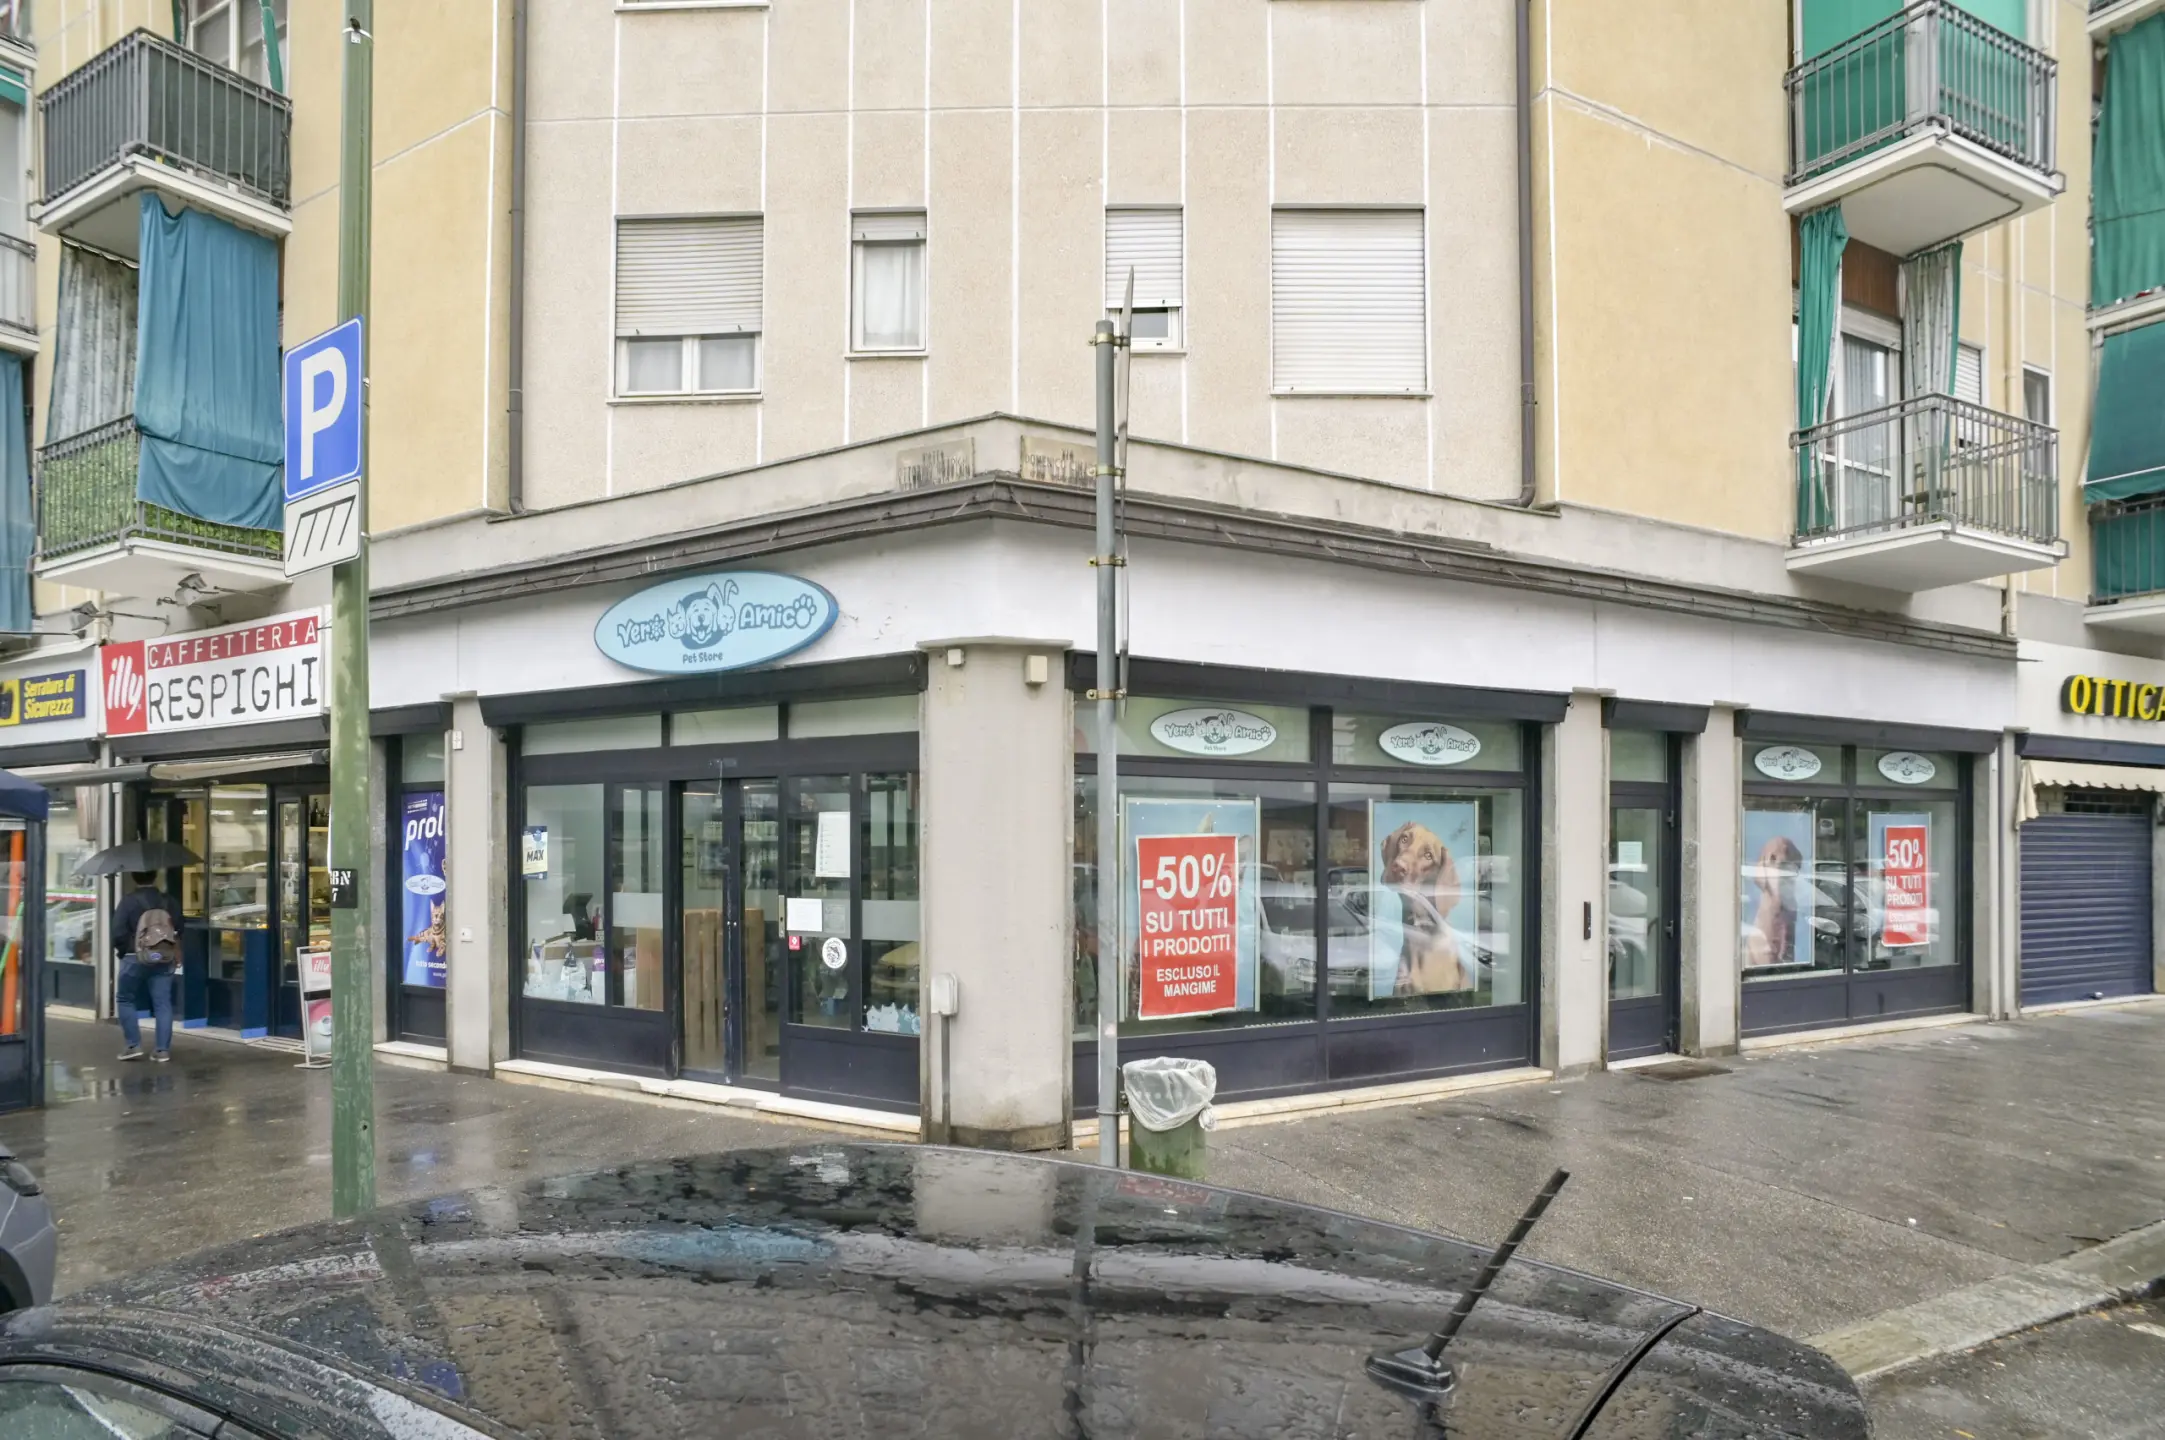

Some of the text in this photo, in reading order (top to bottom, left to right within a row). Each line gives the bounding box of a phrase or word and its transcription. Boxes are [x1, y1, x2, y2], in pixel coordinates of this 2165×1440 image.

[300, 346, 347, 481] P
[617, 593, 817, 648] Vero Amico
[149, 620, 317, 668] CAFFETTERIA
[682, 652, 723, 664] Pet Store
[107, 655, 143, 720] illy
[149, 656, 318, 724] RESPIGHI
[24, 697, 74, 720] Sicurezza
[526, 849, 544, 862] MAX
[1142, 853, 1232, 900] -50%
[1146, 908, 1228, 933] SU TUTTI
[1144, 934, 1230, 957] I PRODOTTI
[1157, 964, 1220, 982] ESCLUSO IL
[1164, 980, 1216, 997] MANGIME
